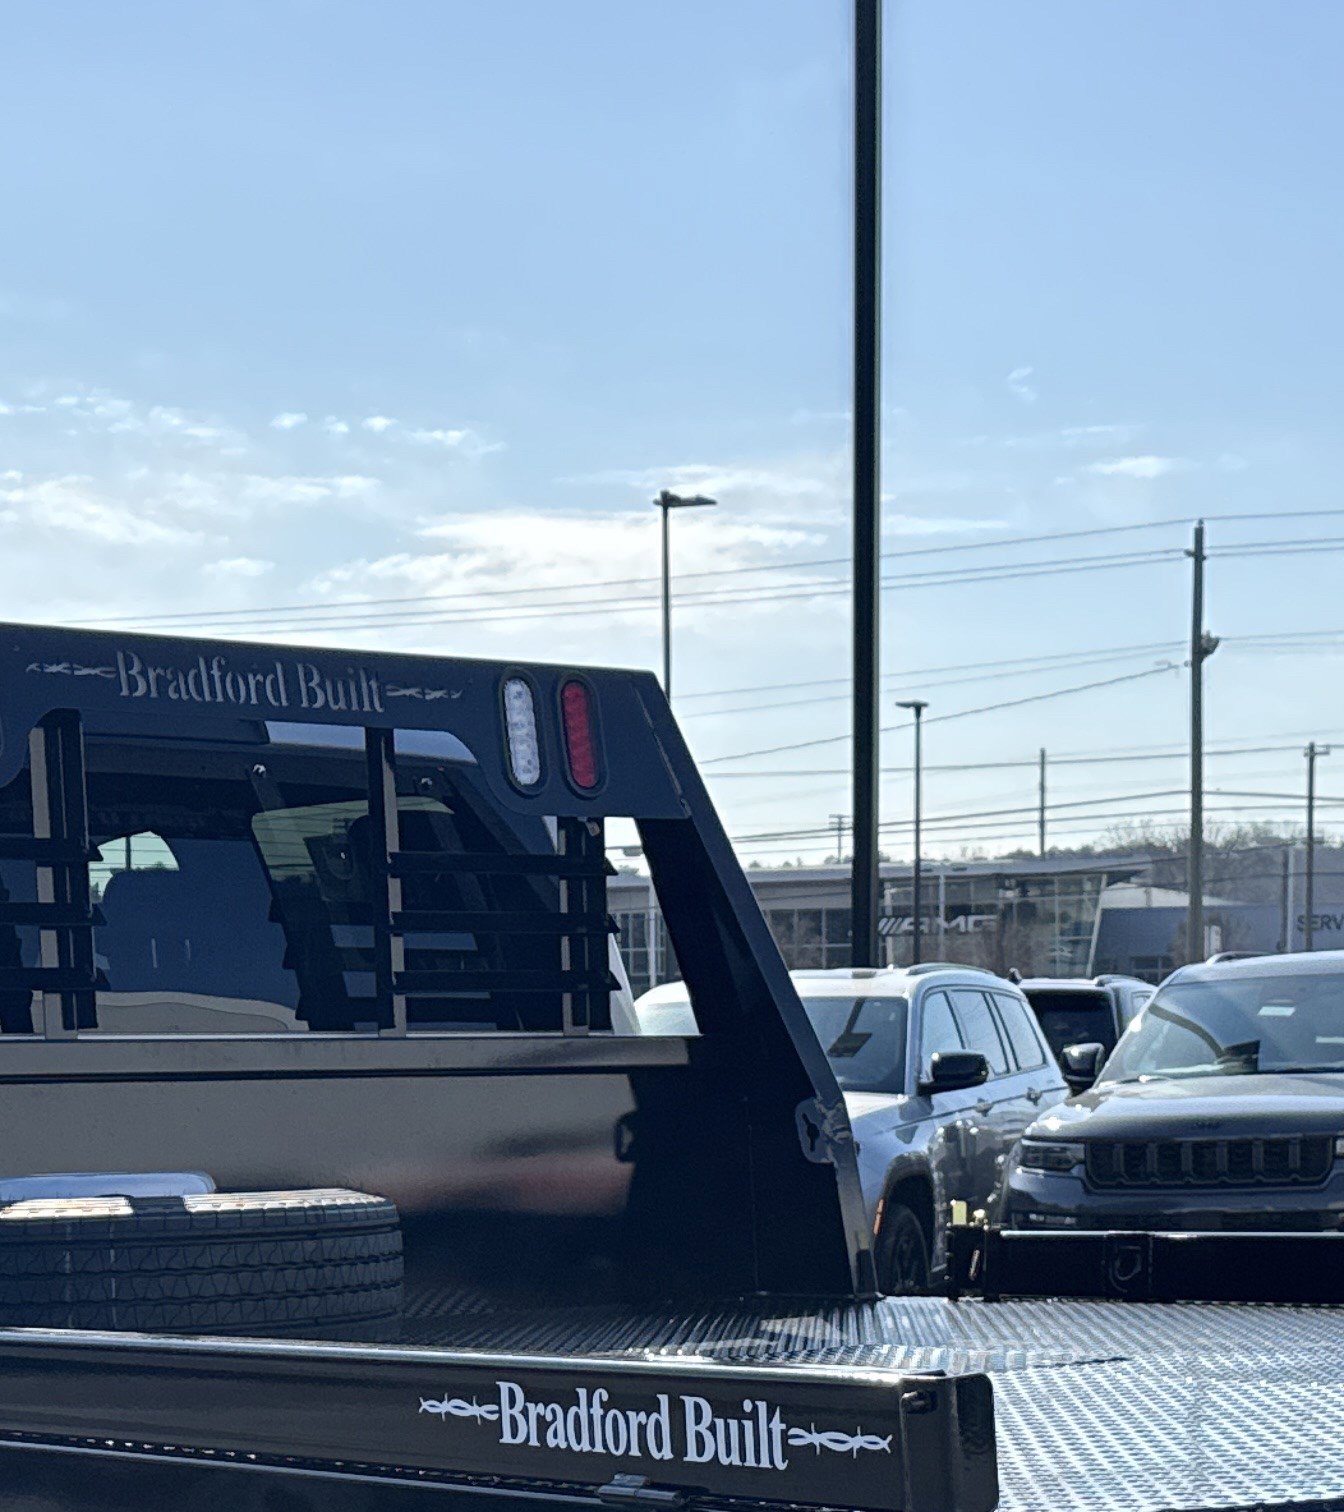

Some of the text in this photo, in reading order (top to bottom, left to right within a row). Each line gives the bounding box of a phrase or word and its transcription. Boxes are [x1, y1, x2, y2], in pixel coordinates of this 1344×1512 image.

[116, 650, 385, 713] Bradford Built
[495, 1380, 789, 1471] Bradford Built
